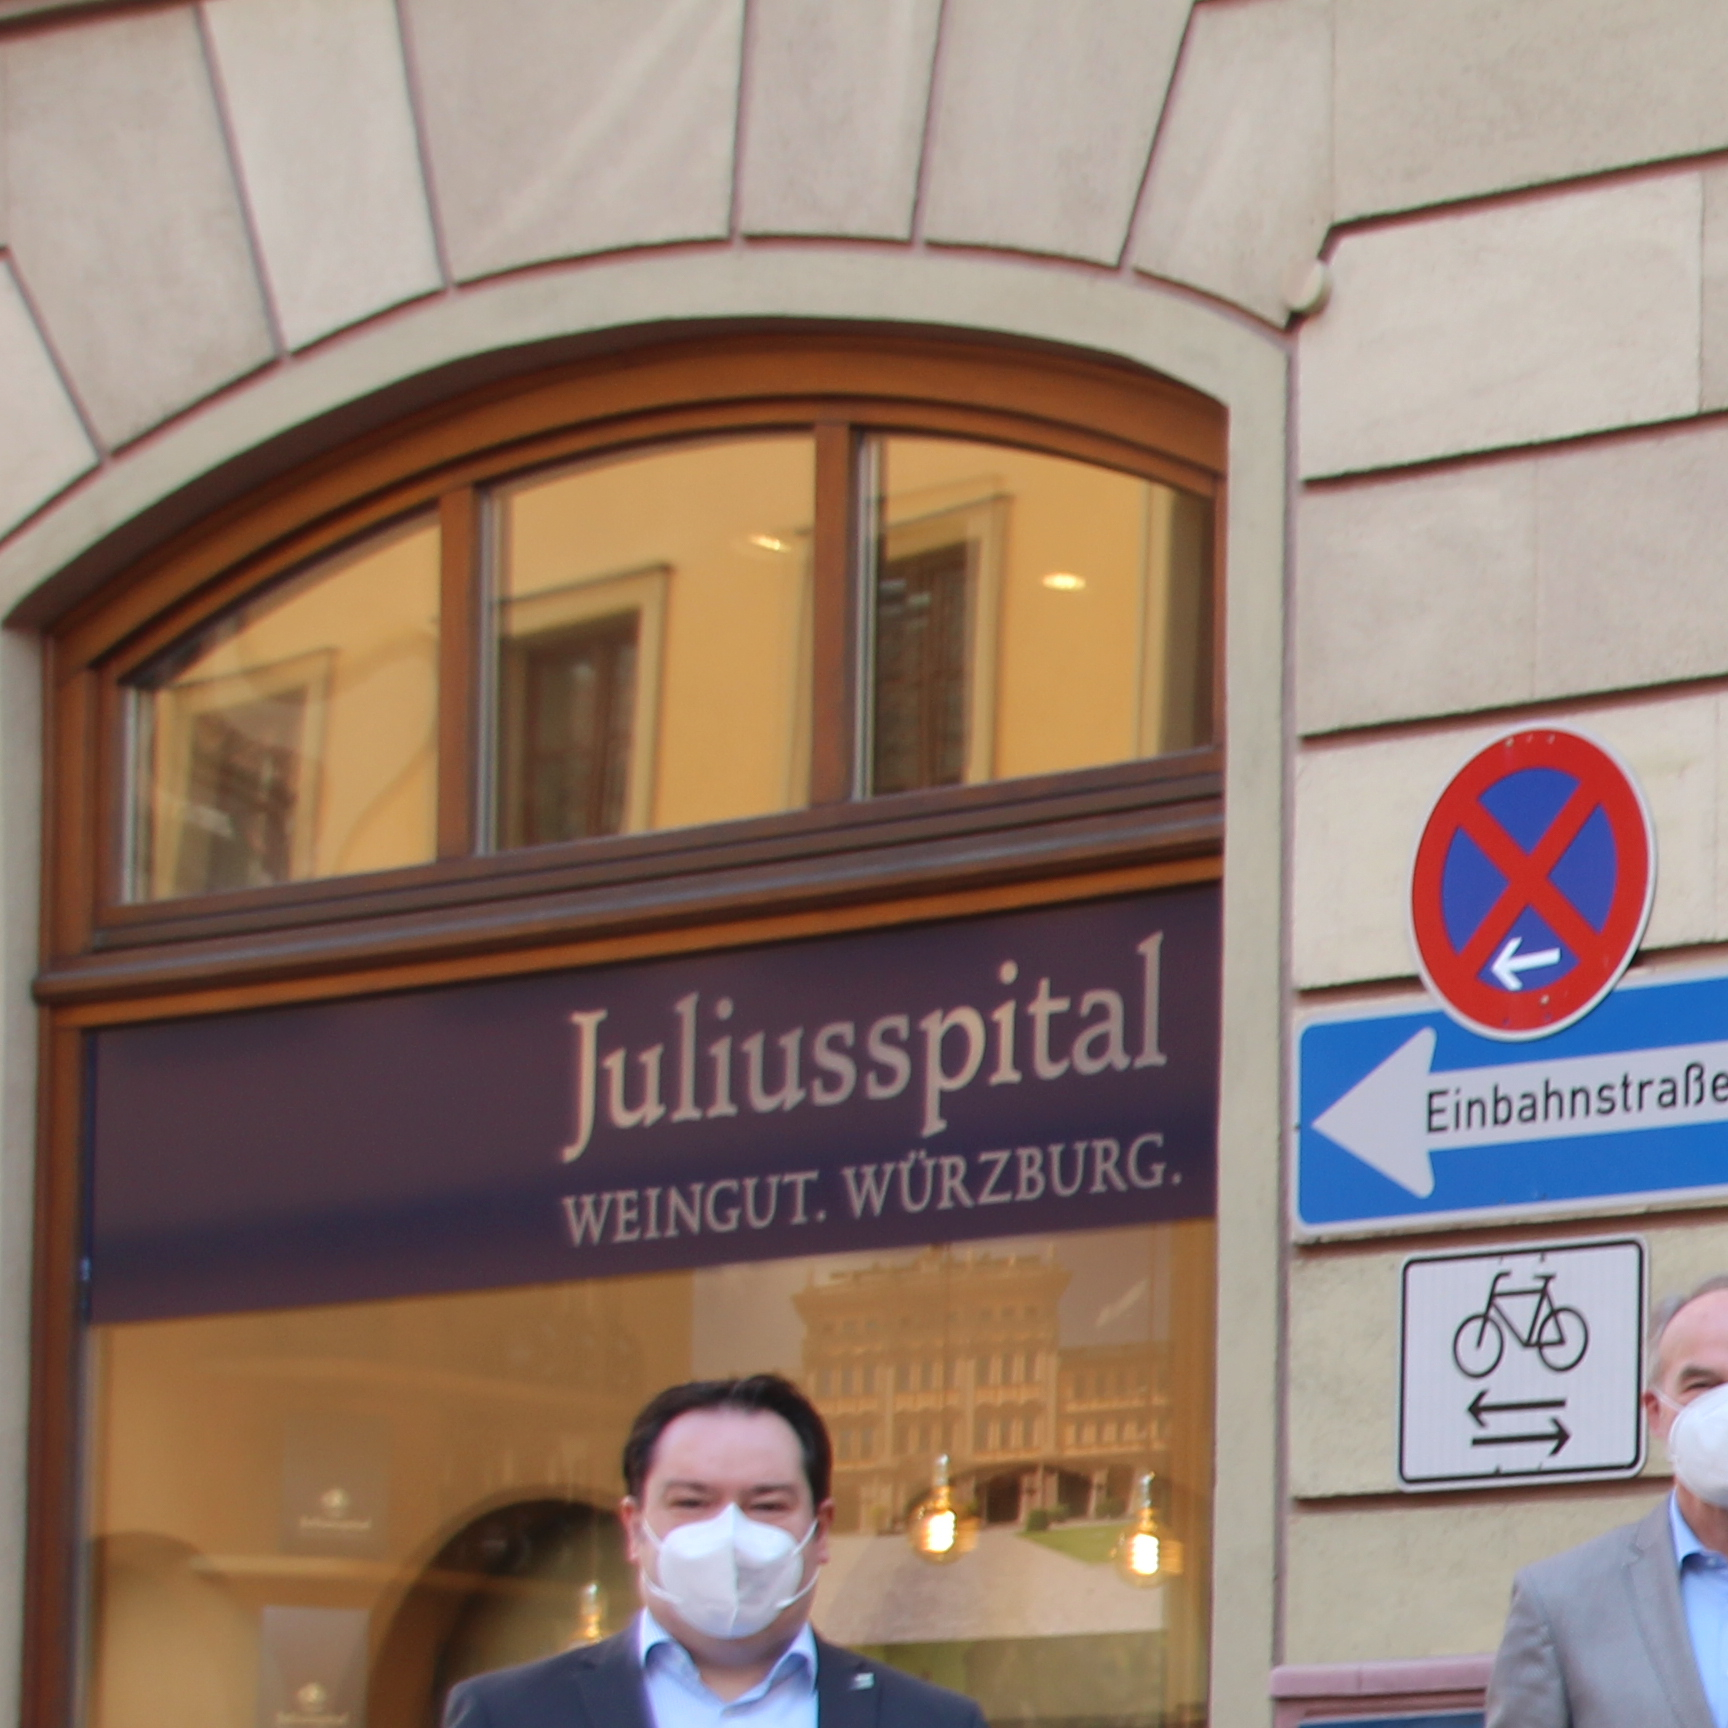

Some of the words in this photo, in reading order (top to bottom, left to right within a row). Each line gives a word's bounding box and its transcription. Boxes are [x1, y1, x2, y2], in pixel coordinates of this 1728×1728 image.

[562, 931, 1168, 1163] Juliusspital
[562, 1169, 827, 1248] WEINGUT.
[843, 1133, 1184, 1219] WÜRZBURG.
